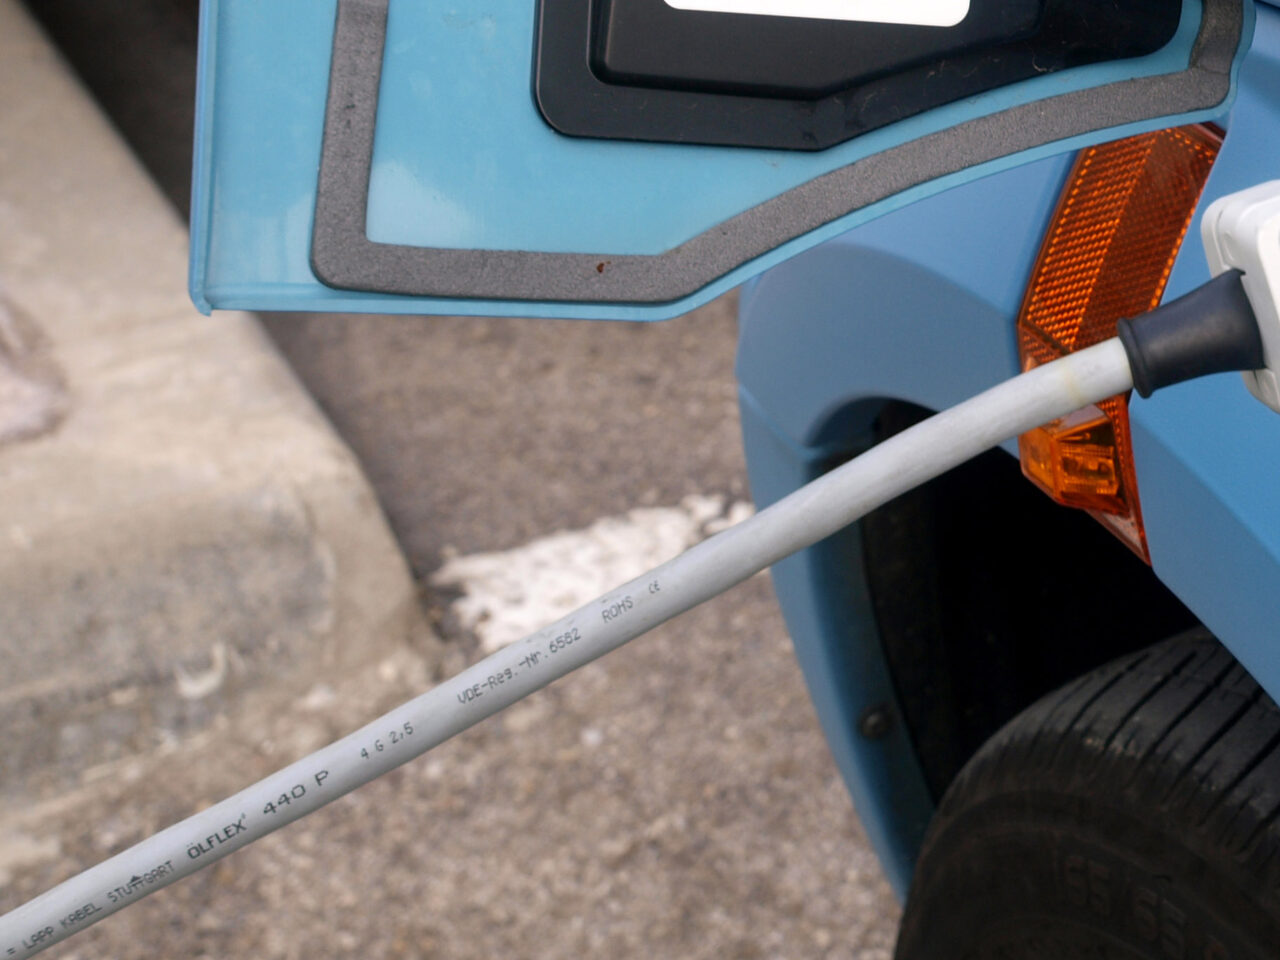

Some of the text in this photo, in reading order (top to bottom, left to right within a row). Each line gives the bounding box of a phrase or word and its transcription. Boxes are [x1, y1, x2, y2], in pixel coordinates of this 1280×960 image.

[22, 926, 55, 950] LAPP
[59, 902, 103, 929] KABEL
[263, 784, 307, 815] 440
[314, 769, 329, 786] P
